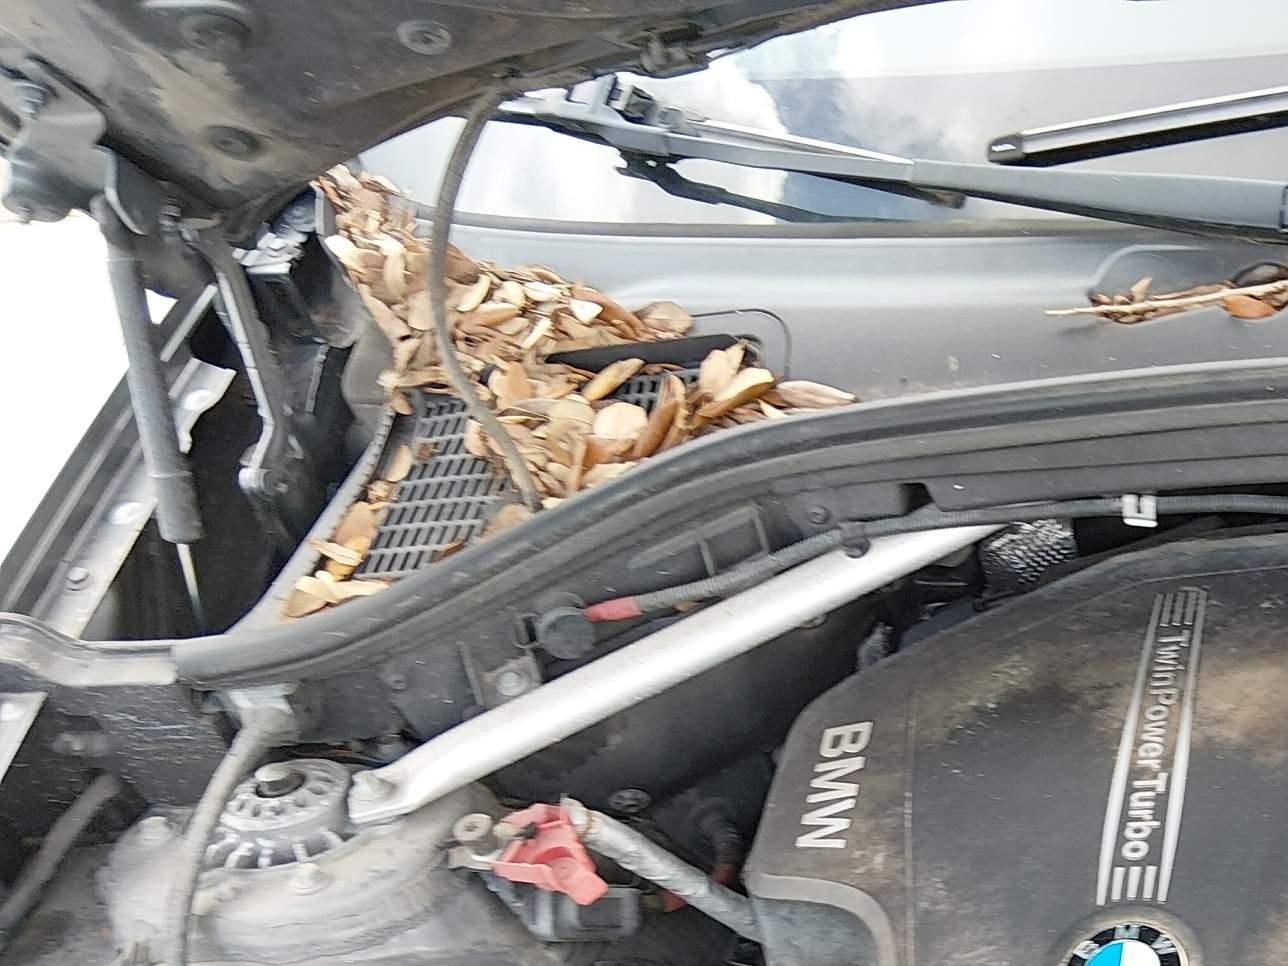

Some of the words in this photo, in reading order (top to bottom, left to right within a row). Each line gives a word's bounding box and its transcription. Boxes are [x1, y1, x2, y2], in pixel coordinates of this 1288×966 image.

[1134, 629, 1191, 770] TwinPower
[795, 721, 874, 848] BMW
[1121, 772, 1169, 861] Turbo
[1072, 924, 1179, 960] BMW
